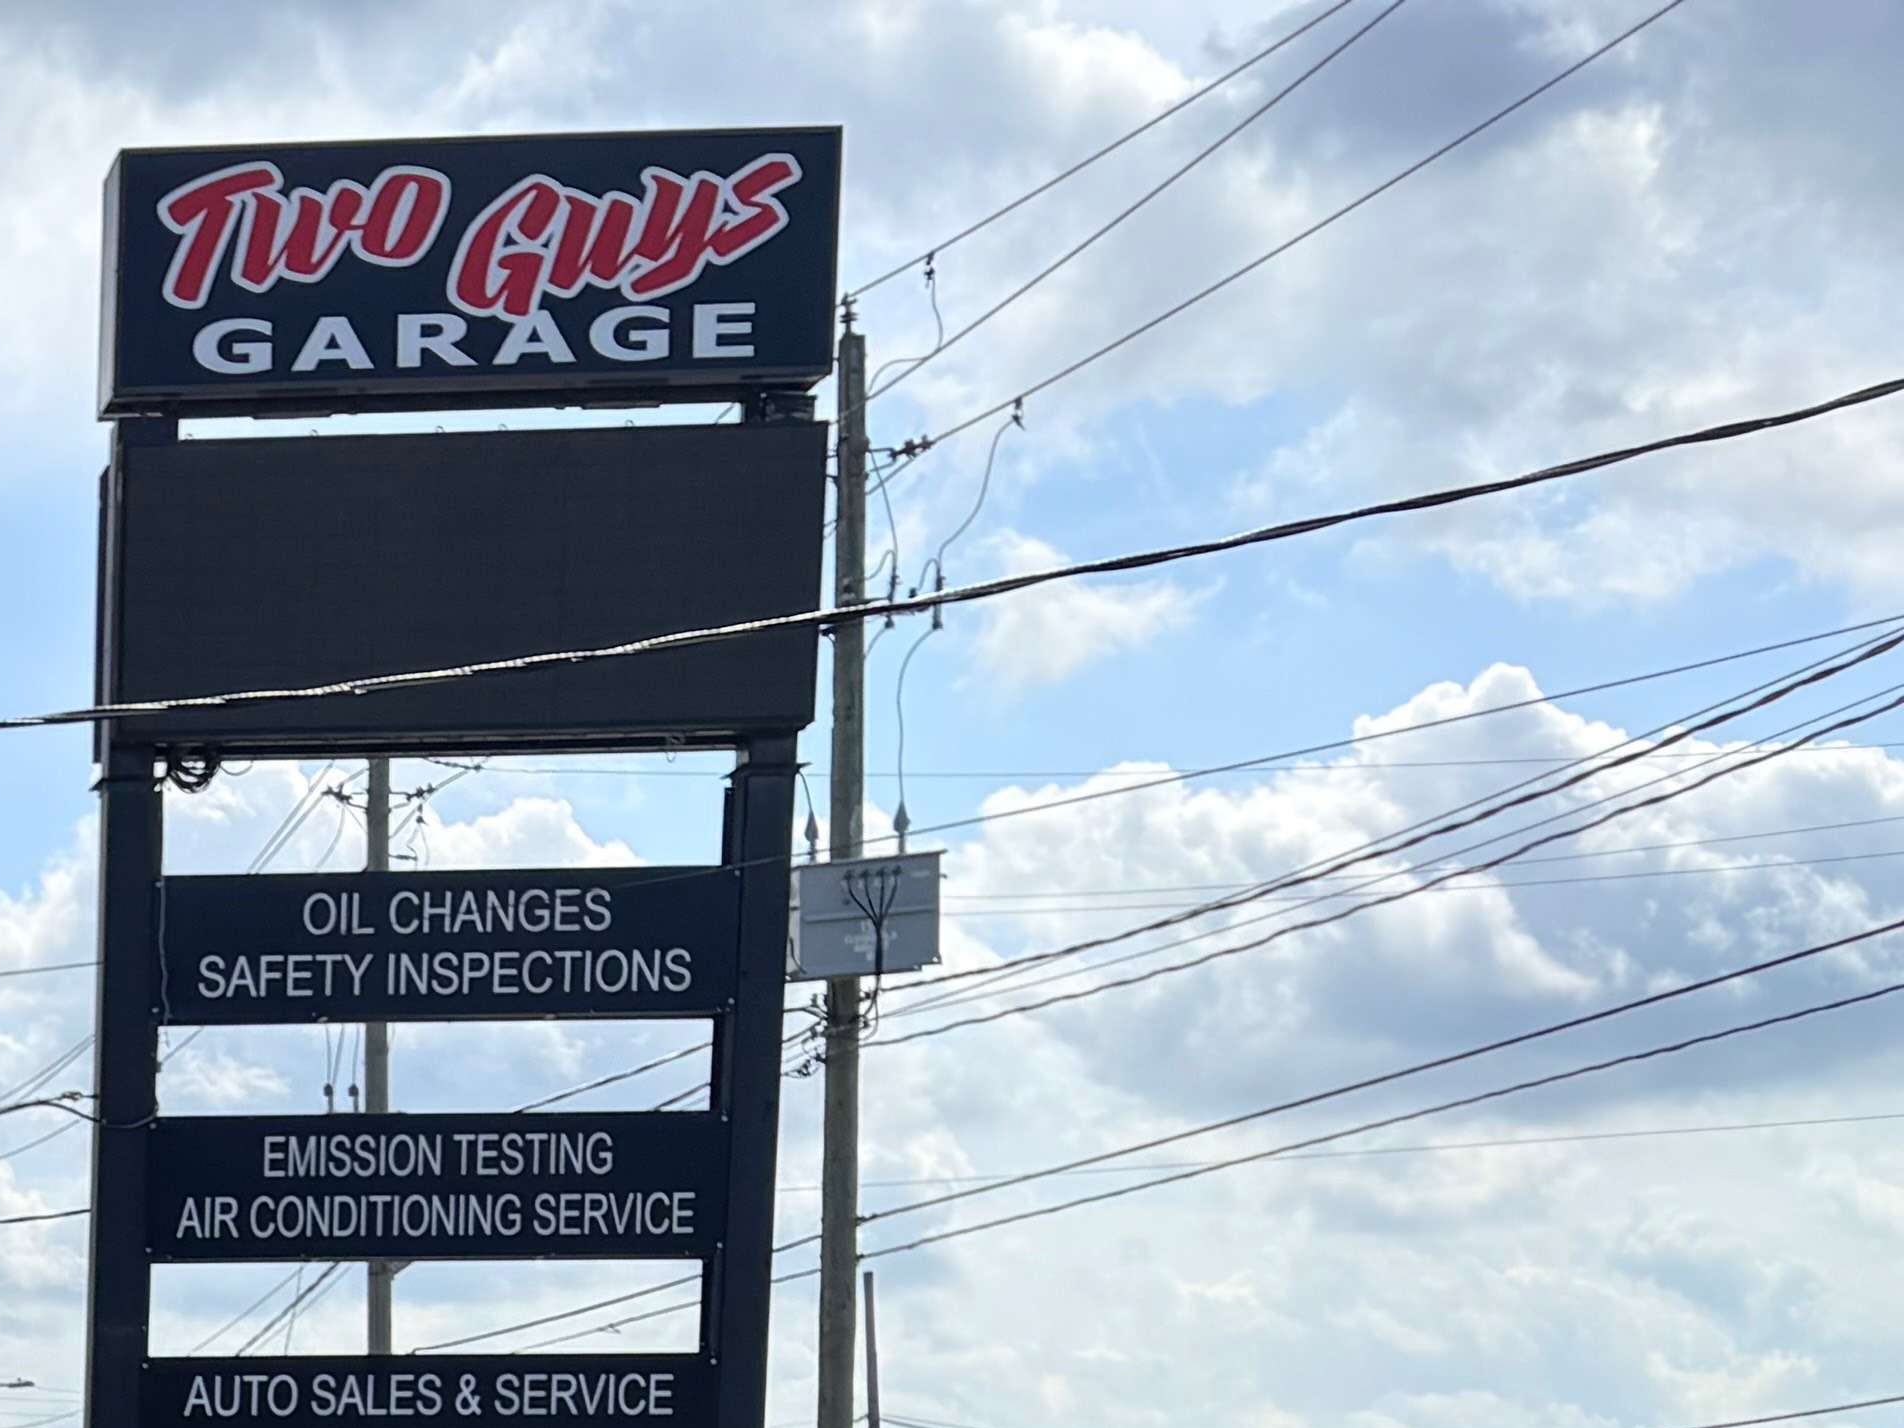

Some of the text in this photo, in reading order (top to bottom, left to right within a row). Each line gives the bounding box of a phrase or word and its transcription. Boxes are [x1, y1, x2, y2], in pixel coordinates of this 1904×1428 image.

[156, 152, 803, 318] Two Guys
[193, 302, 757, 375] GARAGE
[303, 887, 612, 935] OIL CHANGES
[198, 948, 692, 998] SAFETY INSPECTIONS
[263, 1132, 613, 1178] EMISSION TESTING
[176, 1191, 696, 1239] AIR CONDITIONING SERVICE
[183, 1373, 674, 1417] AUTO SALES & SERVICE
